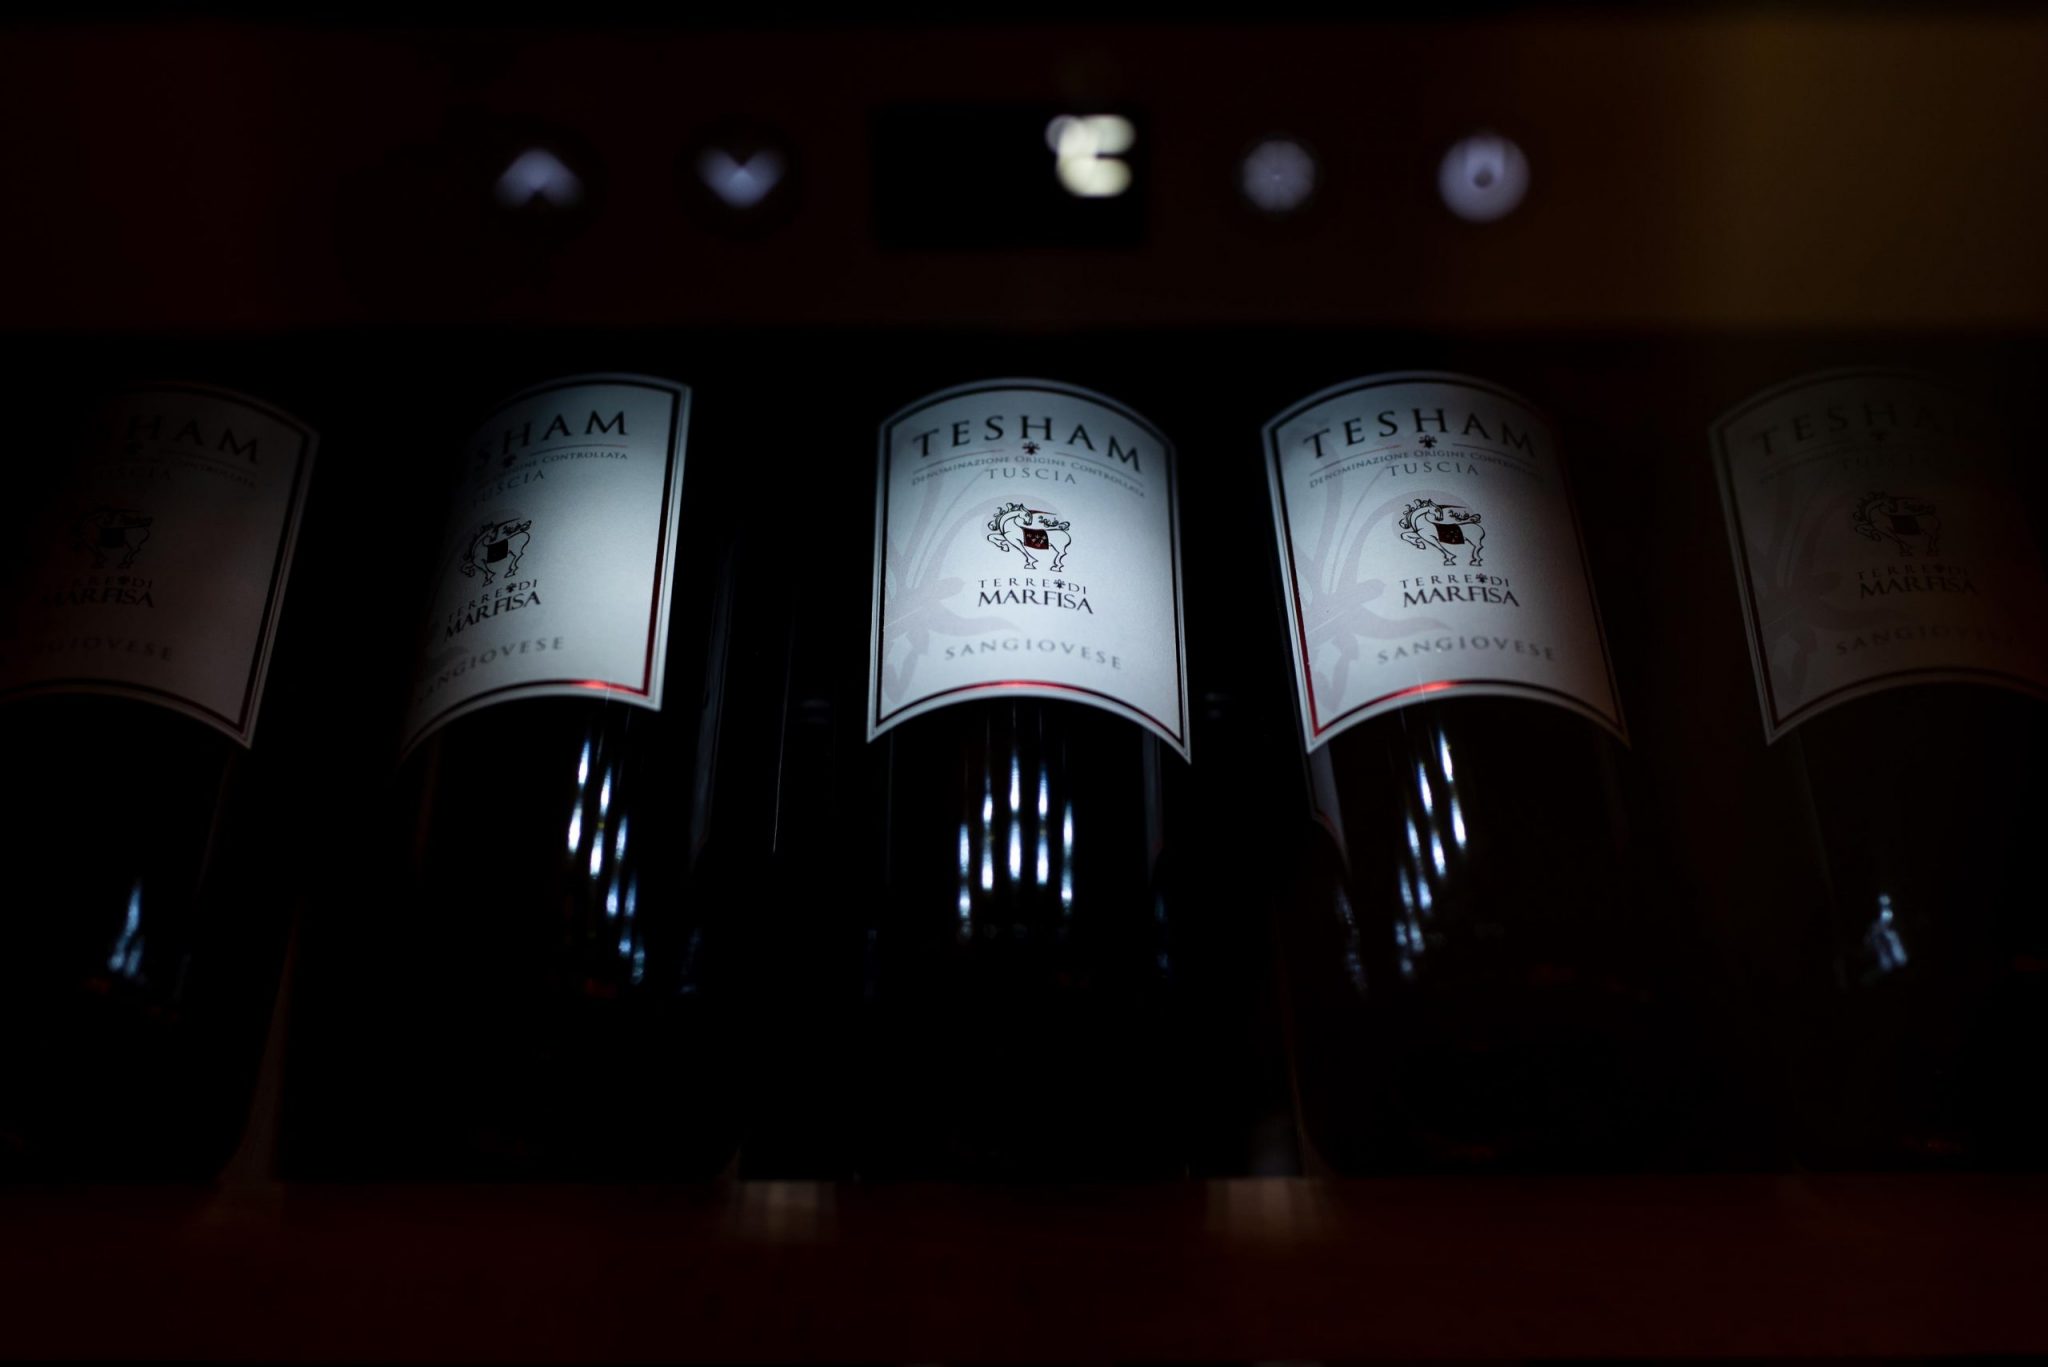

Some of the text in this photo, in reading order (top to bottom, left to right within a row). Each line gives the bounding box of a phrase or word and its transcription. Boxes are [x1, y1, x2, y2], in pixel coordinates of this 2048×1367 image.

[912, 414, 1142, 473] TESHAM
[1302, 407, 1538, 461] TESHAM
[985, 466, 1078, 485] TUSCIA
[1386, 461, 1480, 478] TUSCIA
[518, 579, 538, 591] DI
[978, 577, 1087, 595] TERRE DI
[1400, 573, 1510, 589] TERRE DI
[1860, 576, 1981, 600] MARFISA
[977, 589, 1094, 615] MARFISA
[1402, 585, 1520, 608] MARFISA
[444, 590, 541, 643] MARFISA
[944, 637, 1122, 671] SANGIOVESE
[1377, 634, 1556, 665] SANGIOVESE
